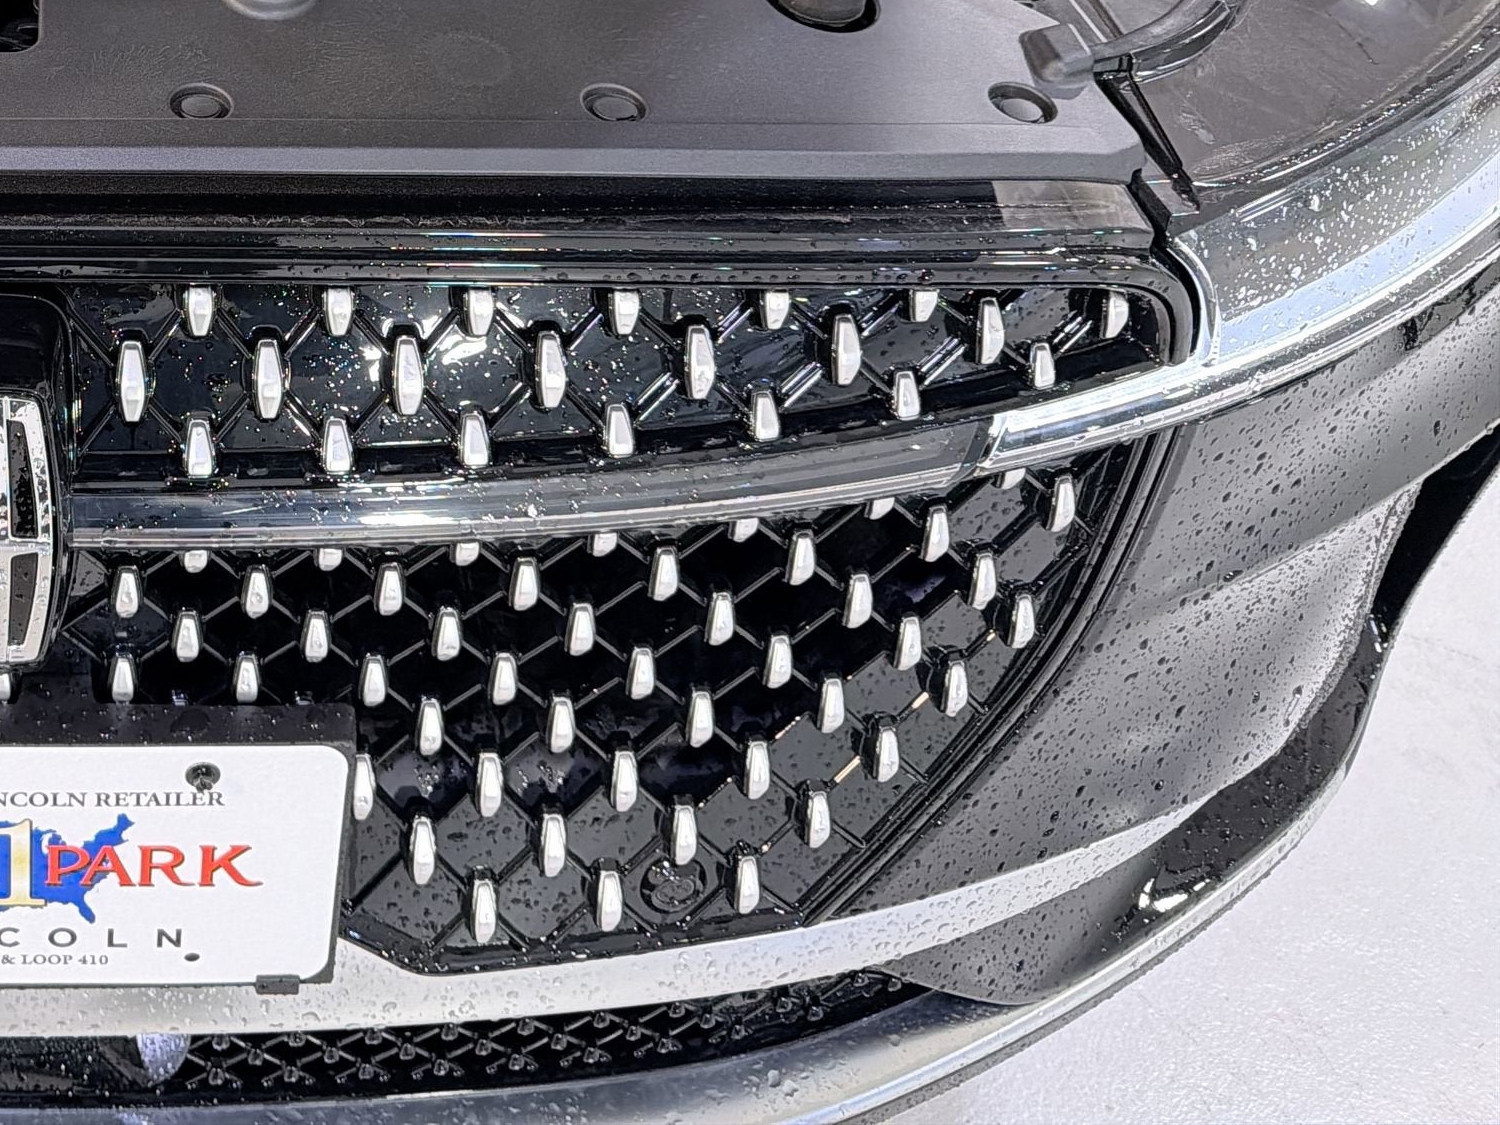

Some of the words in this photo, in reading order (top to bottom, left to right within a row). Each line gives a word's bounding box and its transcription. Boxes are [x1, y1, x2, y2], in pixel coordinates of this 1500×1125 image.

[94, 791, 225, 807] RETAILER
[47, 844, 263, 887] PARK
[1, 953, 16, 965] &
[21, 954, 73, 965] LOOP
[77, 954, 109, 965] 410
